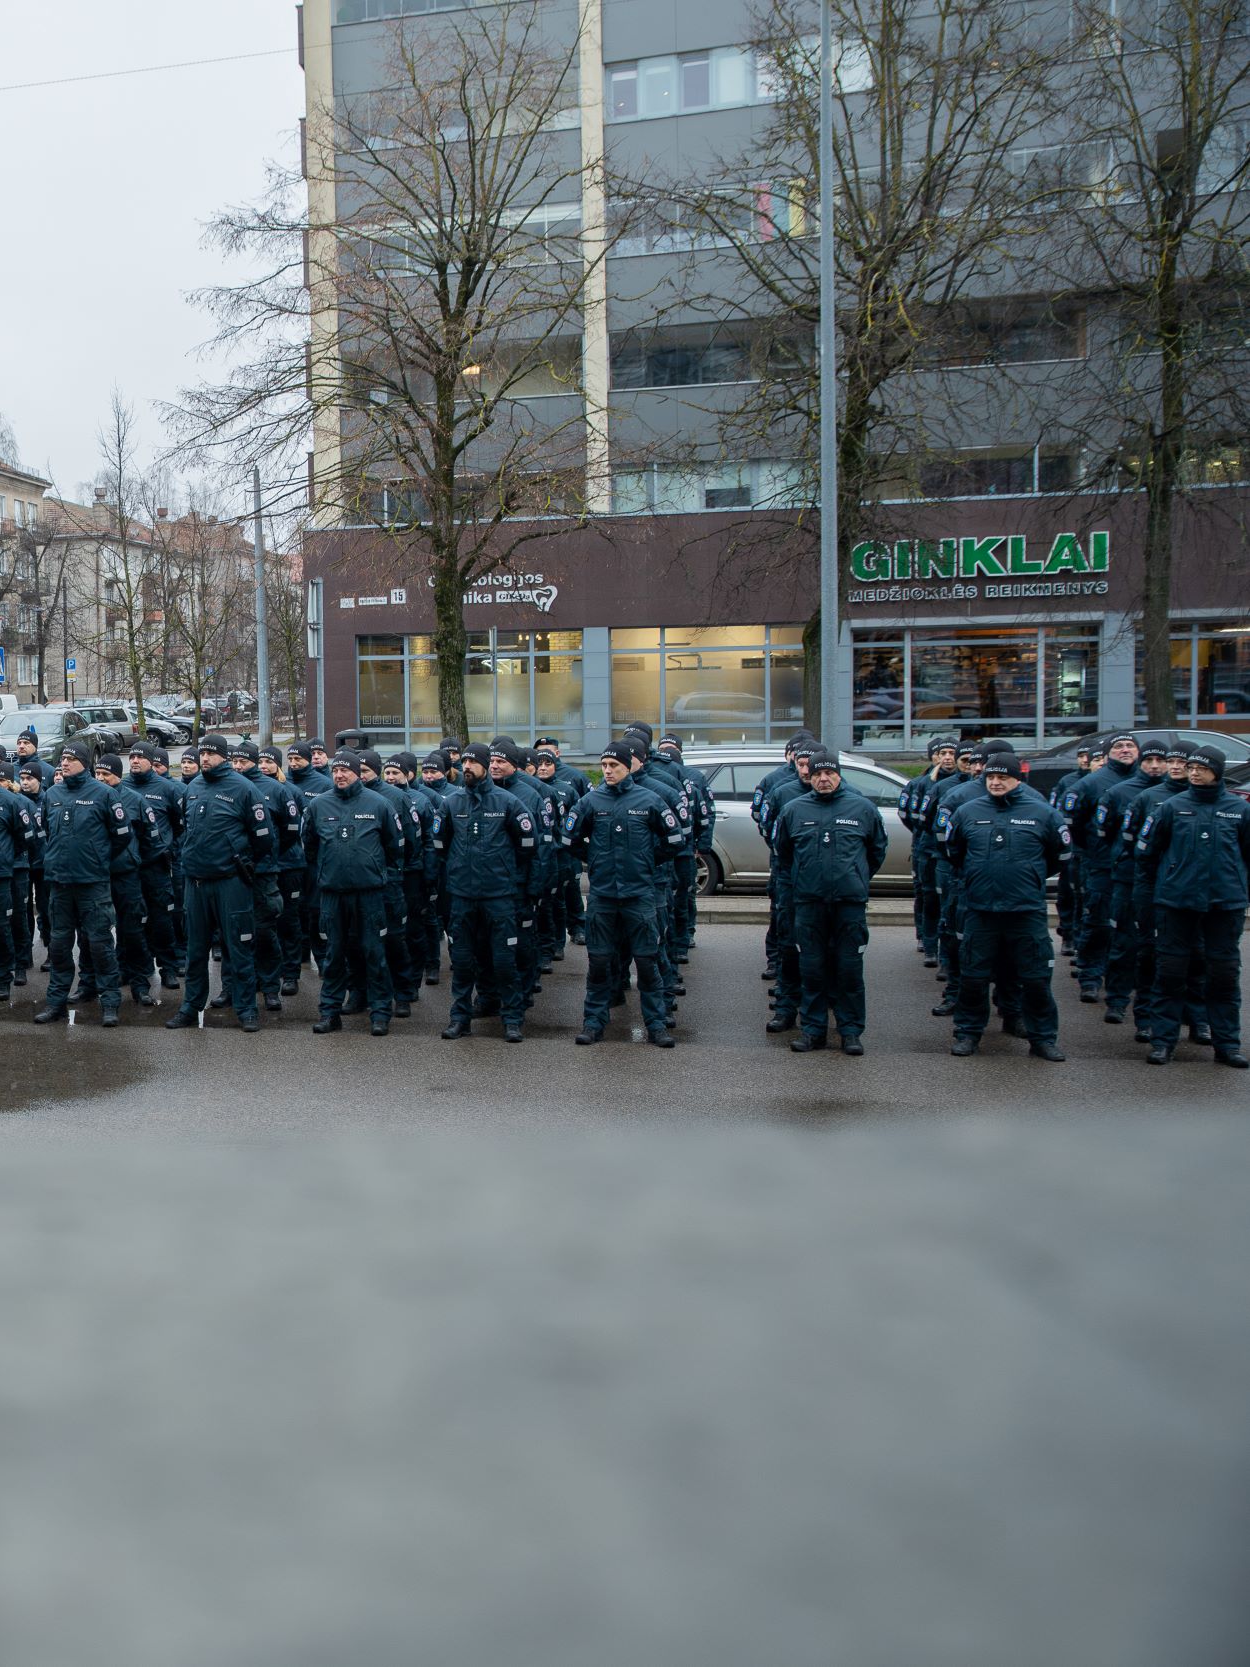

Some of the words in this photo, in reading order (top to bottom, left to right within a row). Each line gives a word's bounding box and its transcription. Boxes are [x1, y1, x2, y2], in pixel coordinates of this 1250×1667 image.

[850, 530, 1110, 582] GINKLAI
[428, 571, 544, 588] Oologijos
[394, 591, 403, 601] 15
[463, 591, 492, 604] nika
[848, 584, 978, 602] MEDŽIOKLĖS
[985, 581, 1109, 598] REIKMENYS
[69, 660, 75, 669] P
